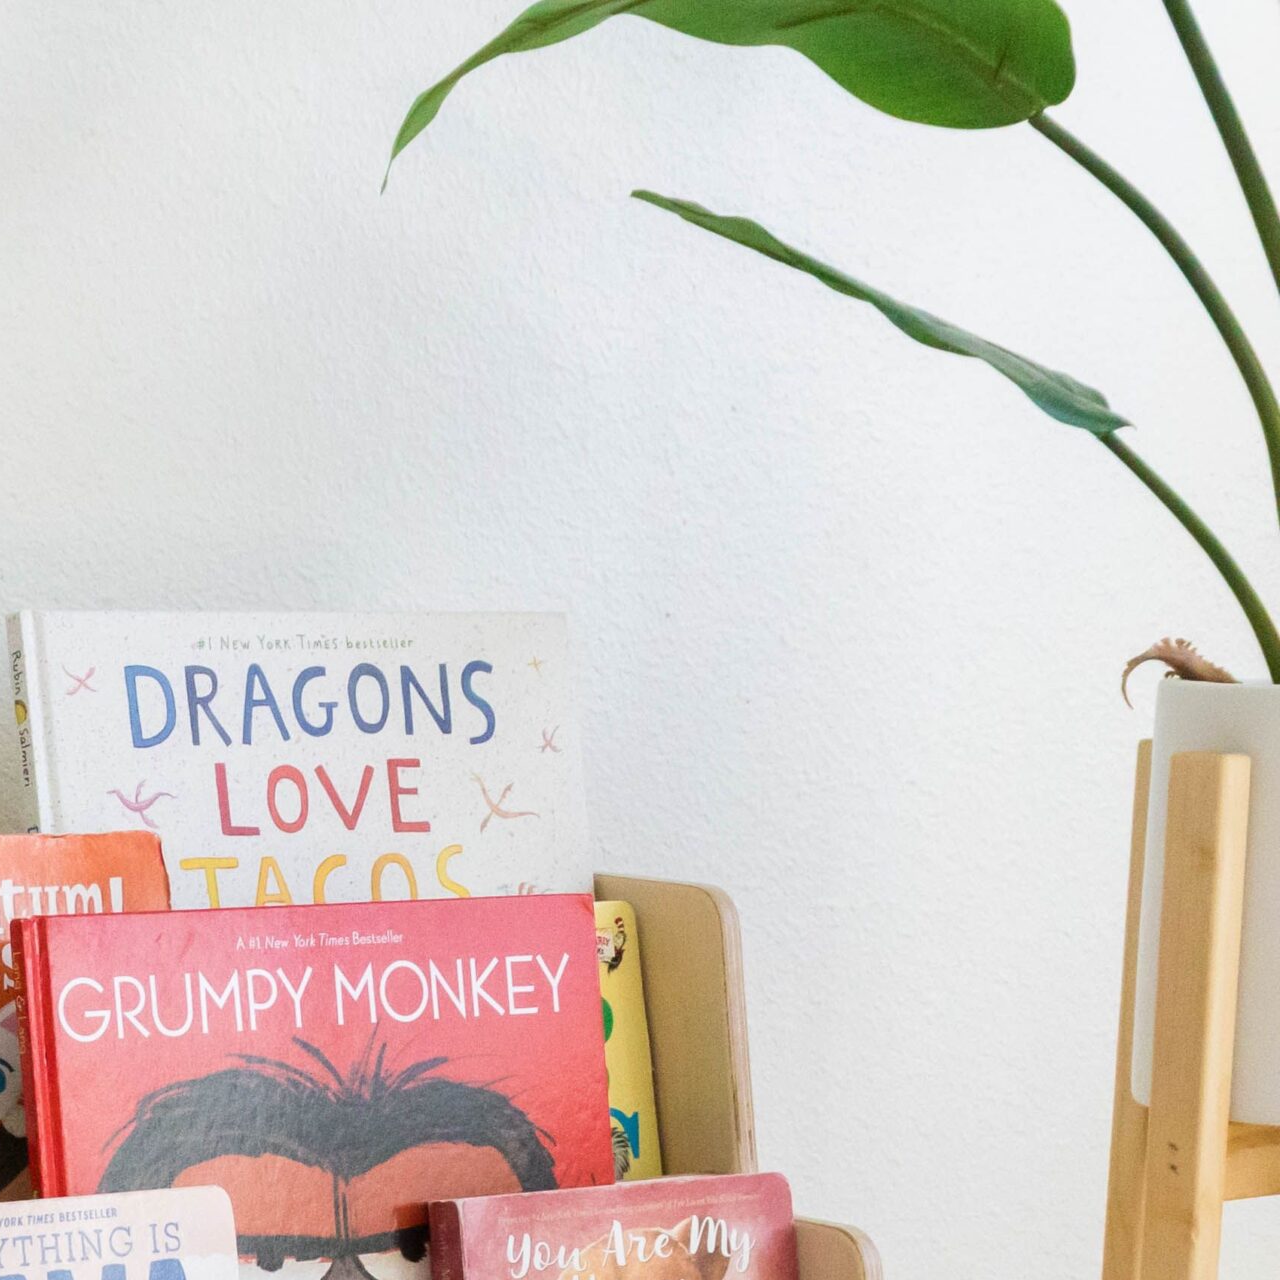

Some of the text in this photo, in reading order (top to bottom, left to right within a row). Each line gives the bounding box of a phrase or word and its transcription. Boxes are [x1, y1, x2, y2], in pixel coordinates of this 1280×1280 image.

[346, 635, 415, 649] bestseller
[12, 650, 32, 788] Rubin Salmieri
[124, 660, 496, 748] DRAGONS
[214, 758, 431, 836] LOVE
[179, 844, 471, 908] TACOS
[236, 930, 404, 950] A #1 New York Times Bestseller
[58, 952, 570, 1042] GRUMPY MONKEY
[27, 1213, 54, 1226] TIMES
[59, 1207, 118, 1223] BESTSELLER
[151, 1222, 181, 1254] IS
[503, 1233, 588, 1279] You
[602, 1219, 673, 1268] Are
[689, 1214, 756, 1273] My
